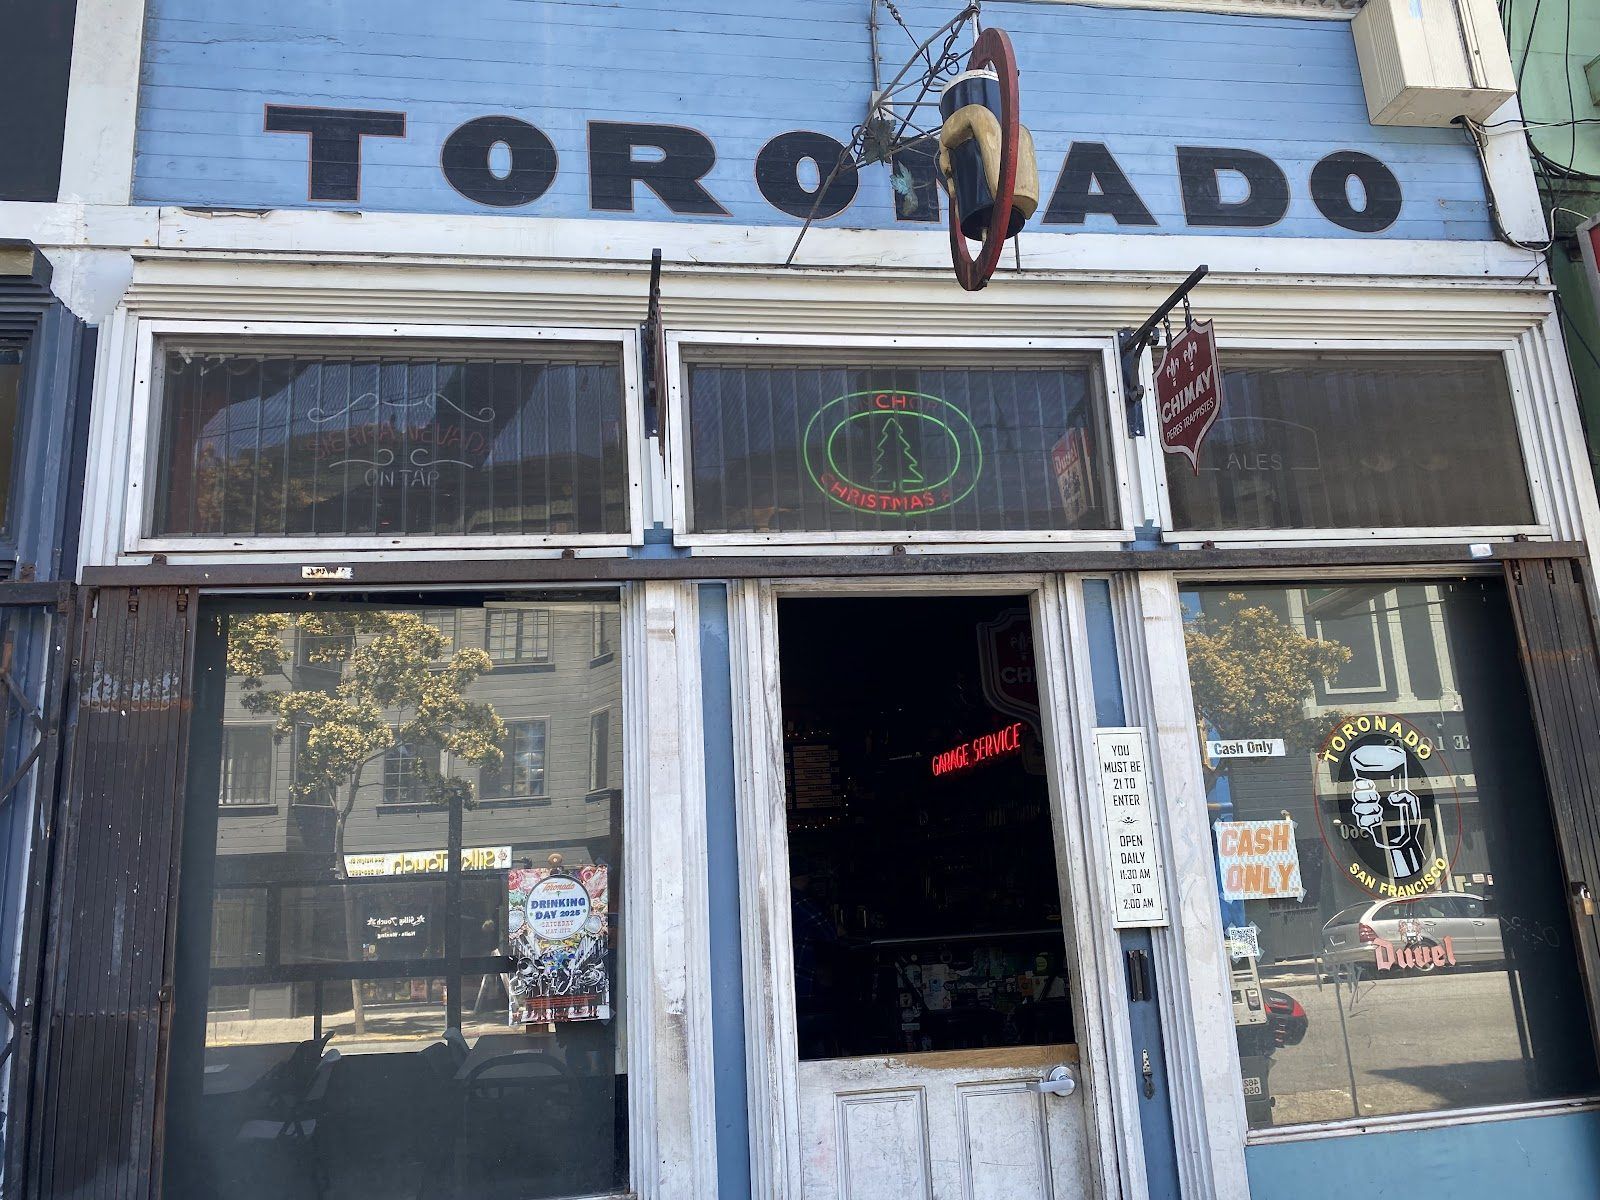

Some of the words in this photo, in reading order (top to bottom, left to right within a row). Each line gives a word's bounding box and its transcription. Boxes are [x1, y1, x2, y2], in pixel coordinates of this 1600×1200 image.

[1161, 365, 1213, 424] CHIMAY
[1166, 421, 1184, 442] PERES
[1182, 397, 1214, 429] TRAPPISTES
[406, 422, 488, 456] NEVAD
[1227, 453, 1282, 470] ALES
[365, 468, 394, 487] ON
[399, 468, 440, 488] TAP
[820, 473, 935, 511] CHRISTMAS
[1324, 716, 1432, 764] TORONADO
[932, 743, 969, 777] GARAGE
[973, 723, 1022, 762] SERVICE
[1111, 745, 1130, 756] YOU
[1214, 742, 1244, 755] Cash
[1247, 741, 1273, 755] Only
[1104, 761, 1127, 773] MUST
[1130, 761, 1142, 772] BE
[1113, 778, 1122, 789] 21
[1124, 778, 1136, 789] TO
[1113, 795, 1140, 806] ENTER
[1119, 835, 1143, 847] OPEN
[1221, 823, 1291, 858] CASH
[1121, 852, 1145, 864] DAILY
[1120, 869, 1138, 880] 11:30
[1140, 868, 1151, 879] AM
[1226, 862, 1295, 895] ONLY
[1350, 863, 1377, 889] SAN
[1379, 857, 1447, 898] FRANCISCO
[1132, 883, 1142, 894] TO
[531, 897, 586, 910] DRINKING
[1123, 898, 1141, 909] 2:00
[1143, 898, 1154, 908] AM
[535, 910, 557, 920] DAY
[560, 909, 581, 917] 2025
[1373, 935, 1457, 971] Duvel
